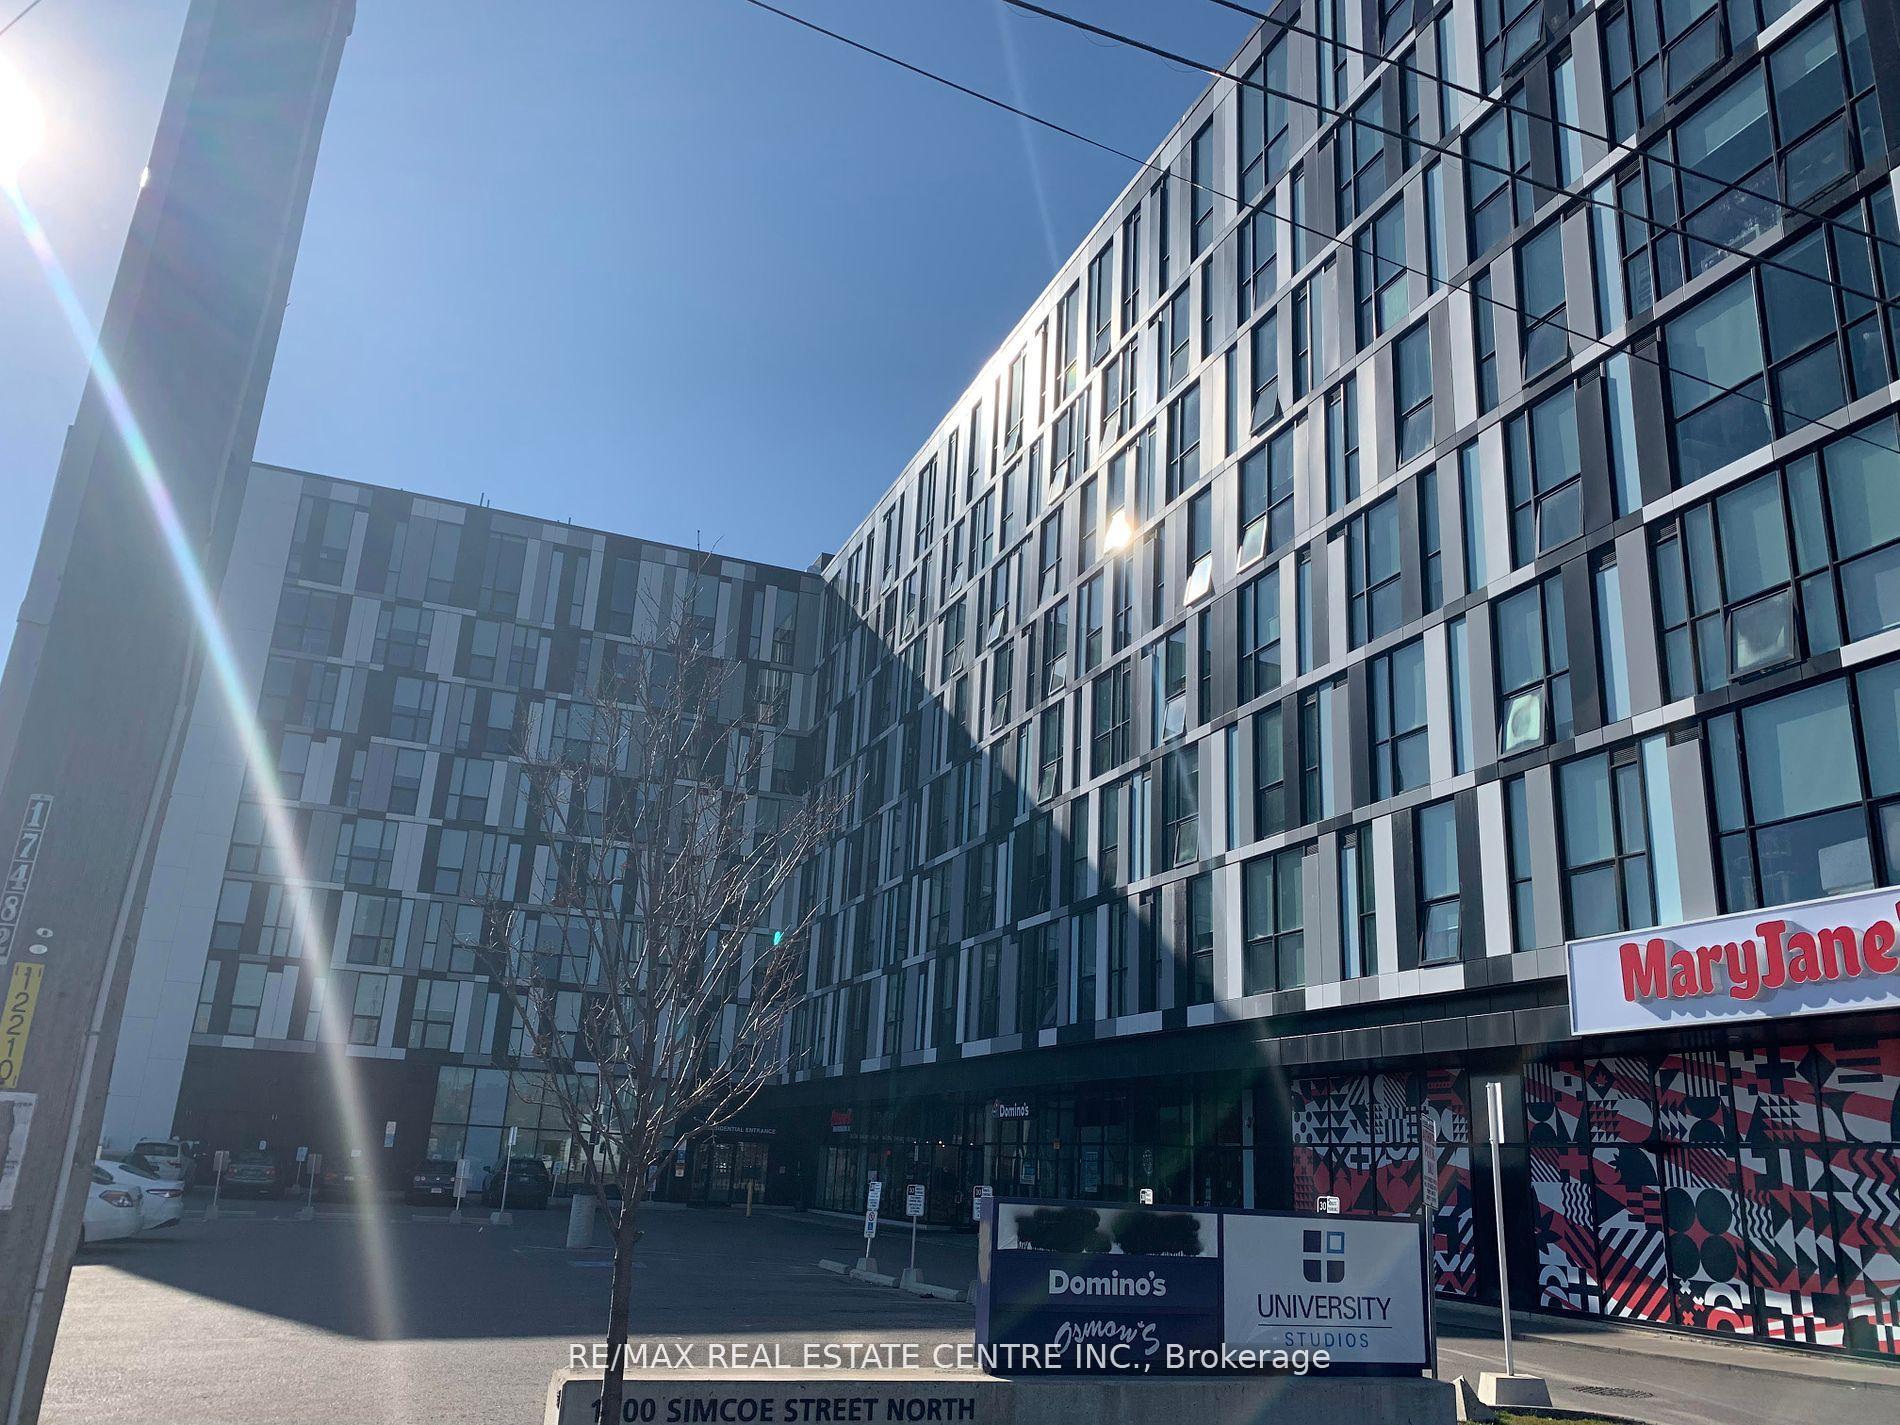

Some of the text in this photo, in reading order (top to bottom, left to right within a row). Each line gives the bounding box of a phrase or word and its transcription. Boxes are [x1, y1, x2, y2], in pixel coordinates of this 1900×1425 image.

[999, 1101, 1030, 1118] Domino's
[1048, 1268, 1167, 1298] Domino's
[1257, 1294, 1392, 1320] UNIVERSITY
[1285, 1331, 1369, 1348] STUDIOS
[591, 1397, 976, 1423] 100 SIMCOE STREET NORTH
